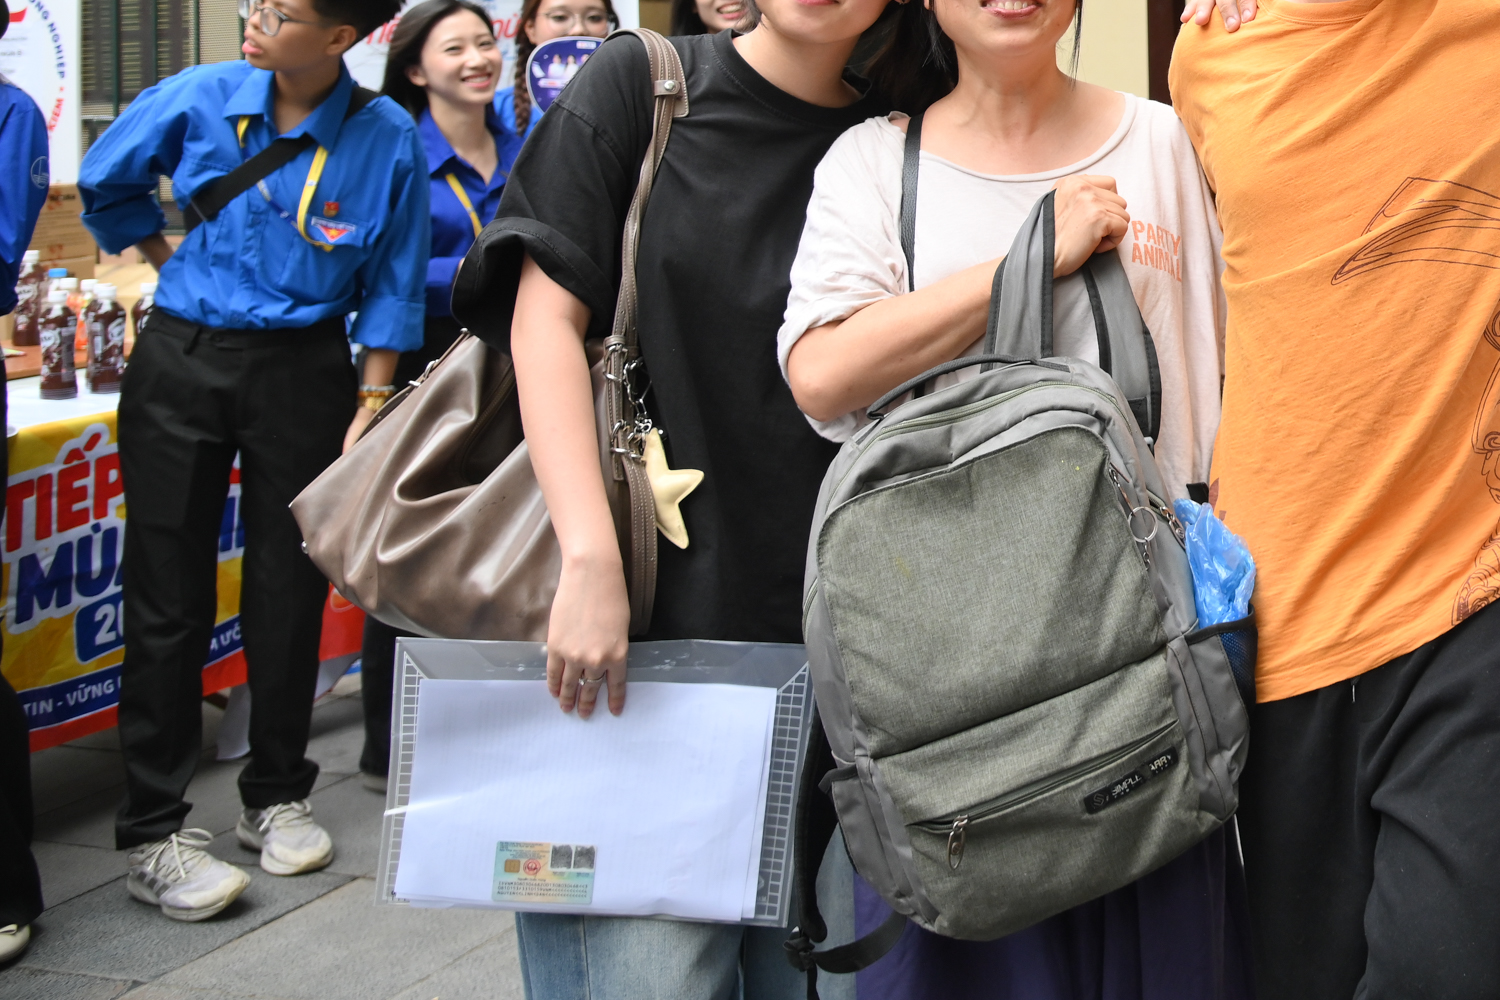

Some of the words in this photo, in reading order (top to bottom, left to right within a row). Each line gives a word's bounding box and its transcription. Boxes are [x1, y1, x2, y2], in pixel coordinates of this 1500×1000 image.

[1131, 220, 1182, 257] PARTY
[1131, 242, 1182, 282] ANIMAL
[5, 432, 124, 552] TIẾP
[15, 522, 123, 625] MÙ
[66, 678, 116, 706] VỮNG
